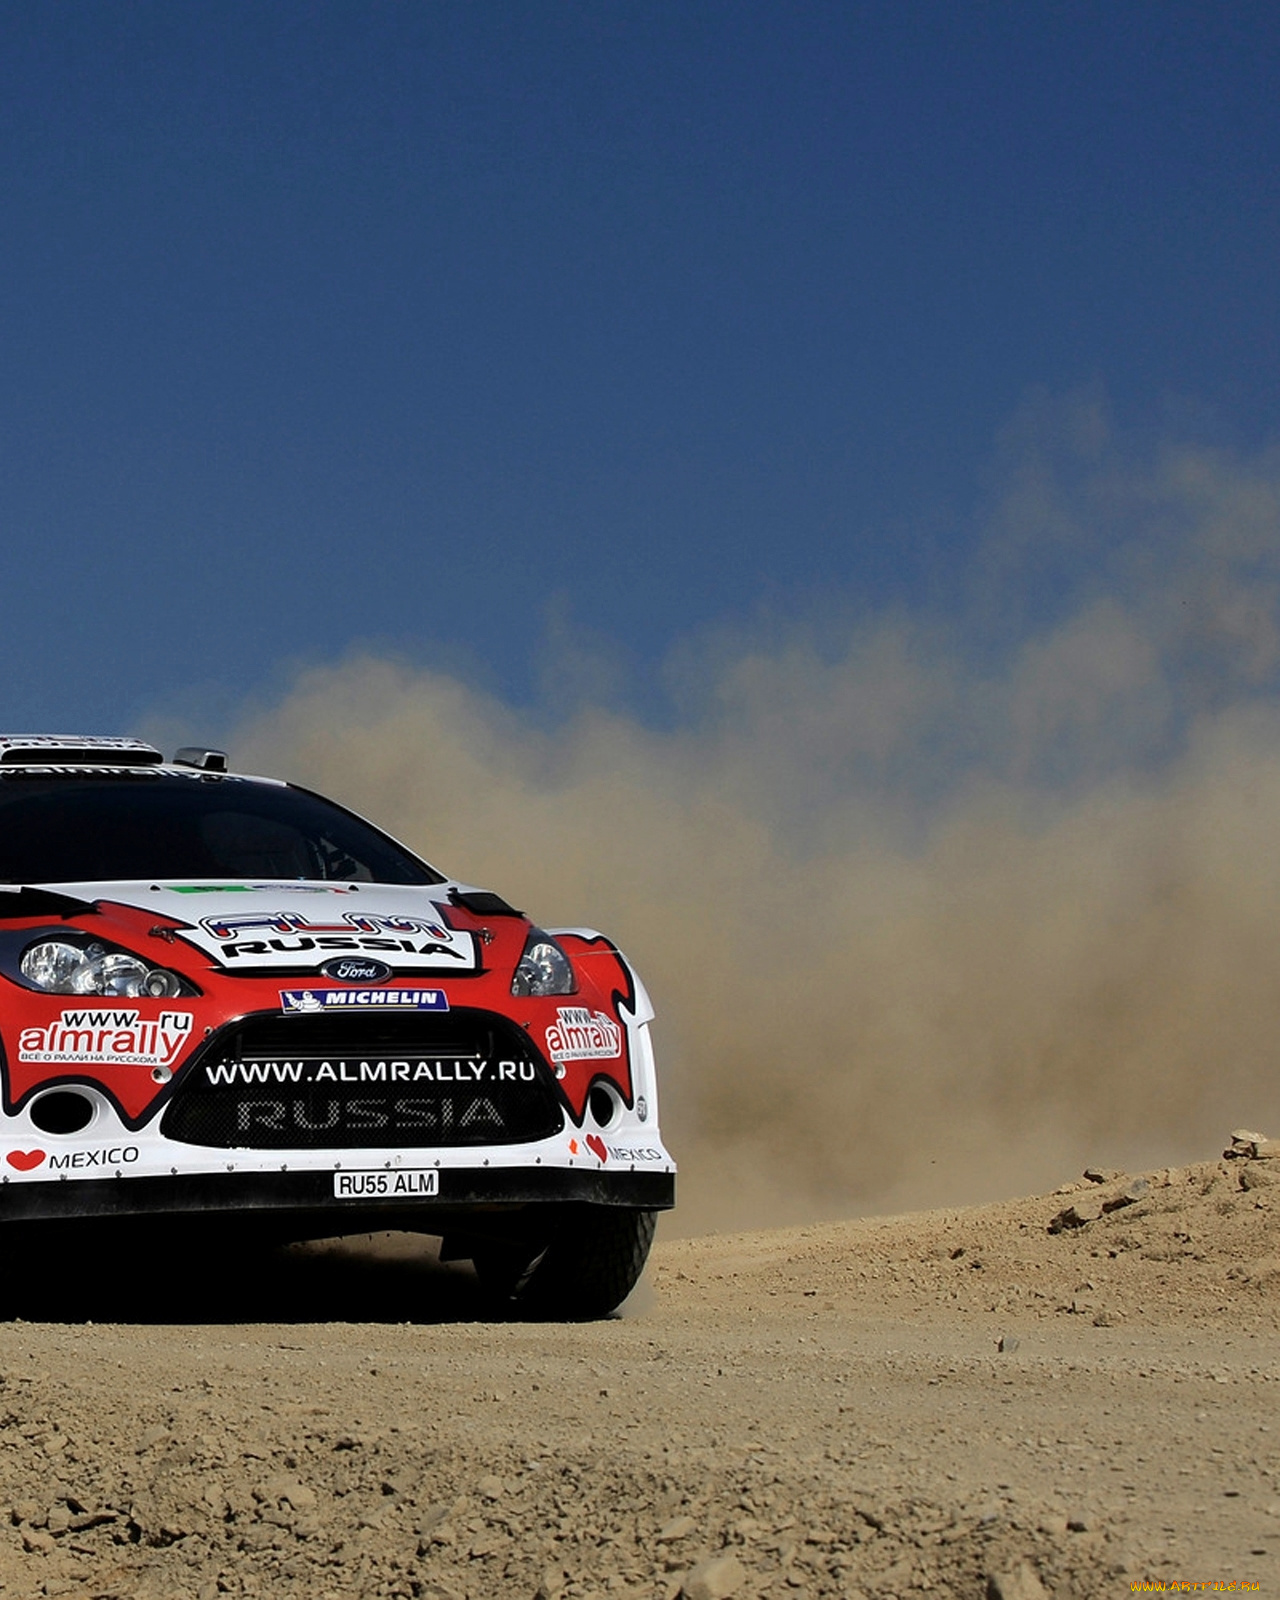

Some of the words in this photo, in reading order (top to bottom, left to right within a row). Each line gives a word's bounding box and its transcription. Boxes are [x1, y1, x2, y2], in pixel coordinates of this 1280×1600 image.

[221, 937, 467, 960] RUSSIA
[337, 963, 377, 979] Ford
[326, 991, 437, 1004] MICHELIN
[21, 1024, 184, 1062] almrally
[548, 1022, 619, 1054] almrally
[206, 1061, 536, 1084] WWW.ALMRALLY.RU
[237, 1098, 506, 1131] RUSSIA
[49, 1147, 139, 1169] MEXICO
[607, 1147, 662, 1161] MEXICO
[339, 1175, 388, 1195] RU55
[393, 1173, 435, 1193] ALM
